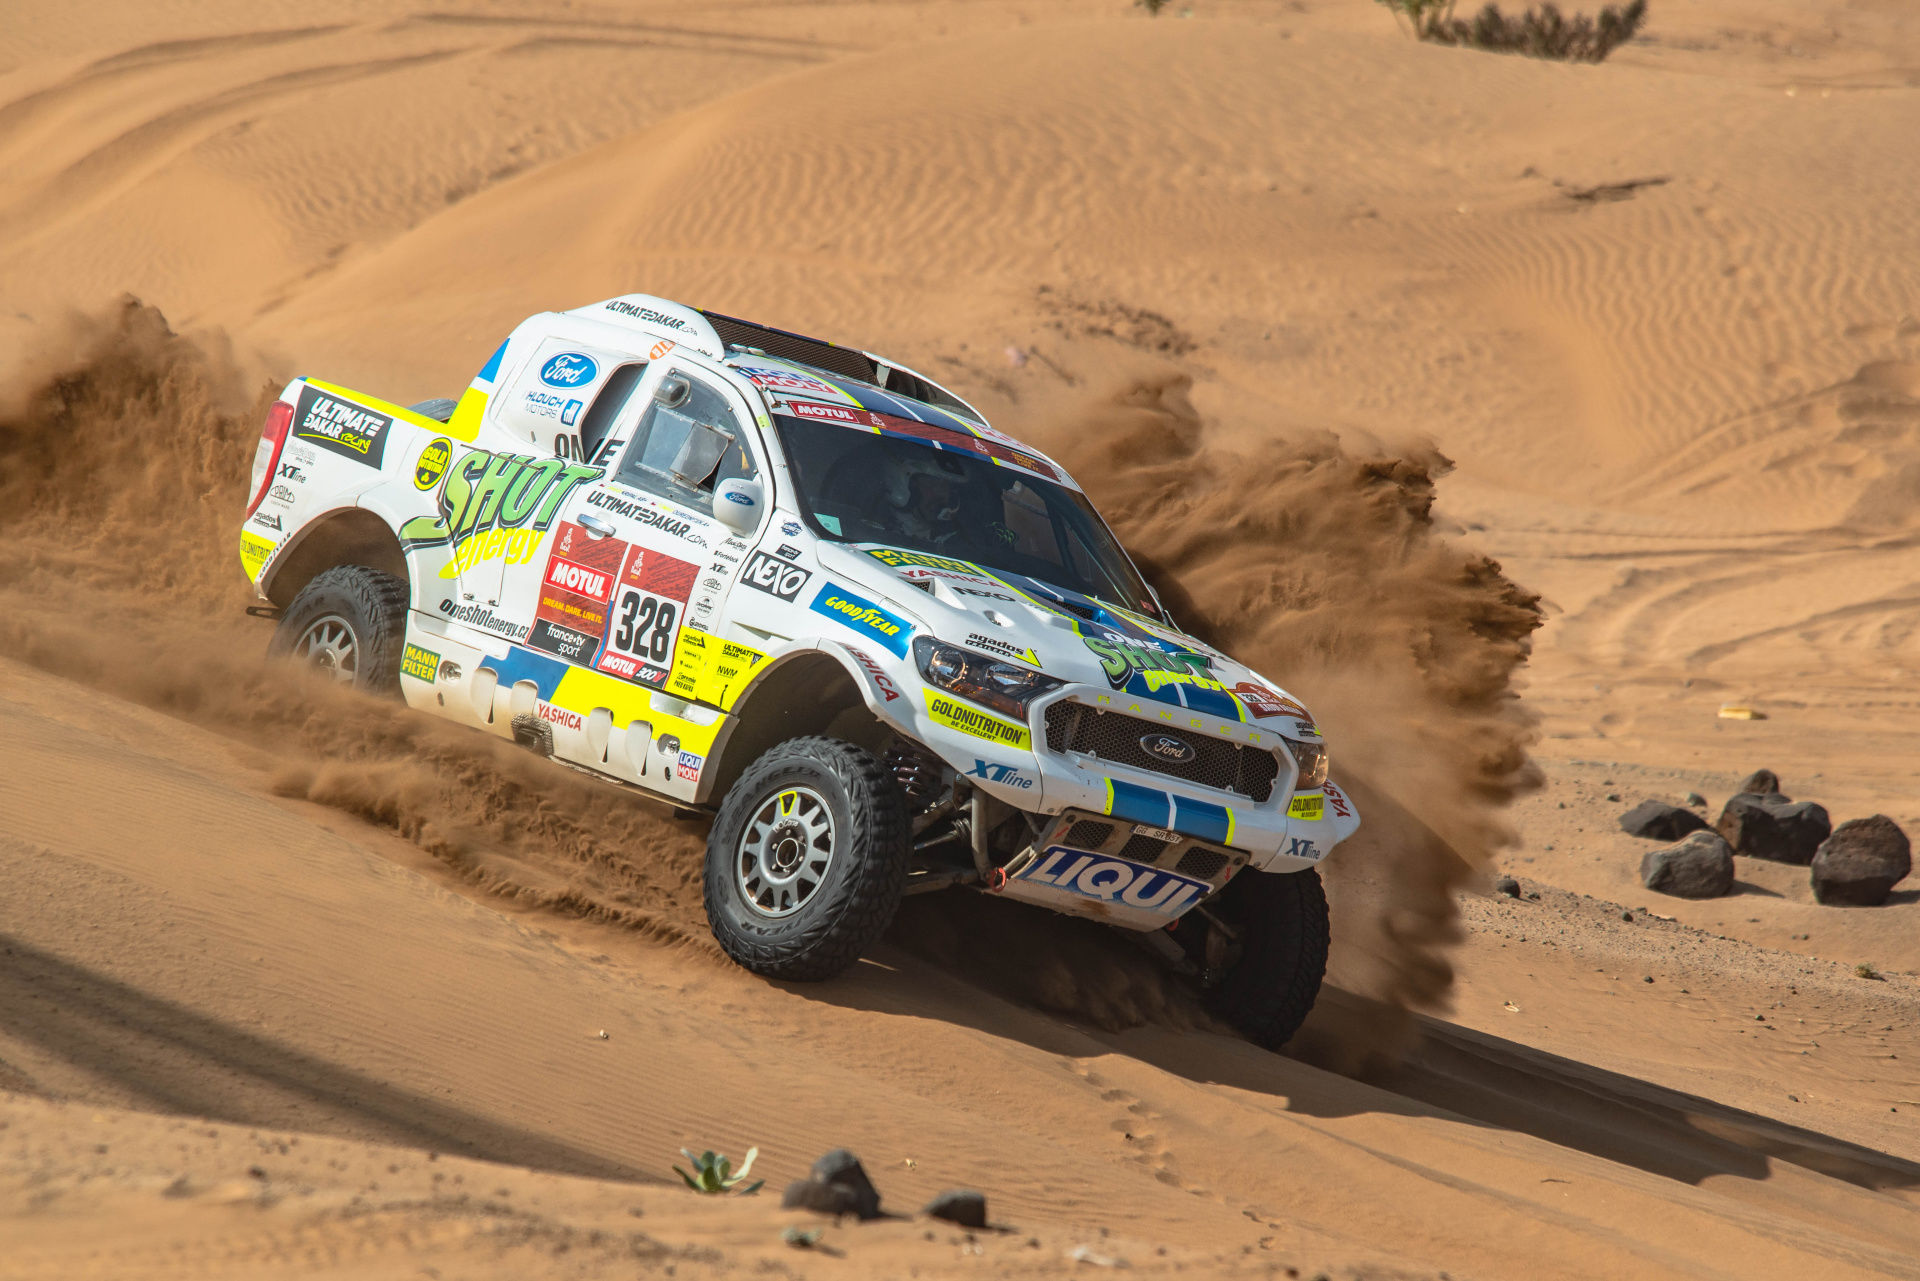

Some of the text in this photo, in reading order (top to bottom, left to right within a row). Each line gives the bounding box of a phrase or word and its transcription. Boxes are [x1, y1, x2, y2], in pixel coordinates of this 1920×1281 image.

[544, 354, 588, 384] Ford
[525, 403, 558, 419] MOTORS
[526, 391, 565, 408] HLOUCH
[310, 396, 386, 438] ULTIMATE
[797, 405, 854, 420] MOTUL
[302, 412, 344, 440] DAKAR
[340, 431, 372, 452] racing
[554, 433, 626, 467] ONE
[423, 446, 449, 466] GOLD
[400, 449, 606, 556] SHOT
[728, 493, 750, 505] Ford
[438, 527, 547, 579] energy
[869, 549, 972, 570] MANN
[550, 562, 605, 597] MOTUL
[743, 555, 807, 596] NEXO
[899, 569, 1006, 589] YASHICA
[439, 598, 530, 640] oneshotenergy.cz
[542, 596, 565, 611] DREAM.
[565, 602, 582, 617] DARE.
[581, 609, 596, 622] LIVE
[824, 596, 901, 636] GOODYEAR
[614, 590, 676, 663] 328
[557, 642, 581, 657] sport
[969, 632, 1025, 655] agados
[1103, 632, 1165, 652] ONE
[405, 646, 439, 667] MANN
[1083, 636, 1216, 691] SHOT
[401, 659, 436, 681] FILTER
[601, 655, 667, 683] MOTUL 300V
[717, 665, 739, 677] NWM
[1142, 669, 1222, 692] energy
[538, 703, 582, 731] YASHICA
[1097, 694, 1262, 744] RANGER
[950, 720, 997, 740] BE EXCELLENT
[1153, 737, 1185, 759] Ford
[678, 752, 701, 769] LIQUI
[677, 765, 699, 782] MOLY
[964, 759, 1033, 789] XTline
[1285, 838, 1321, 860] XTline
[1026, 851, 1200, 913] LIQUI
